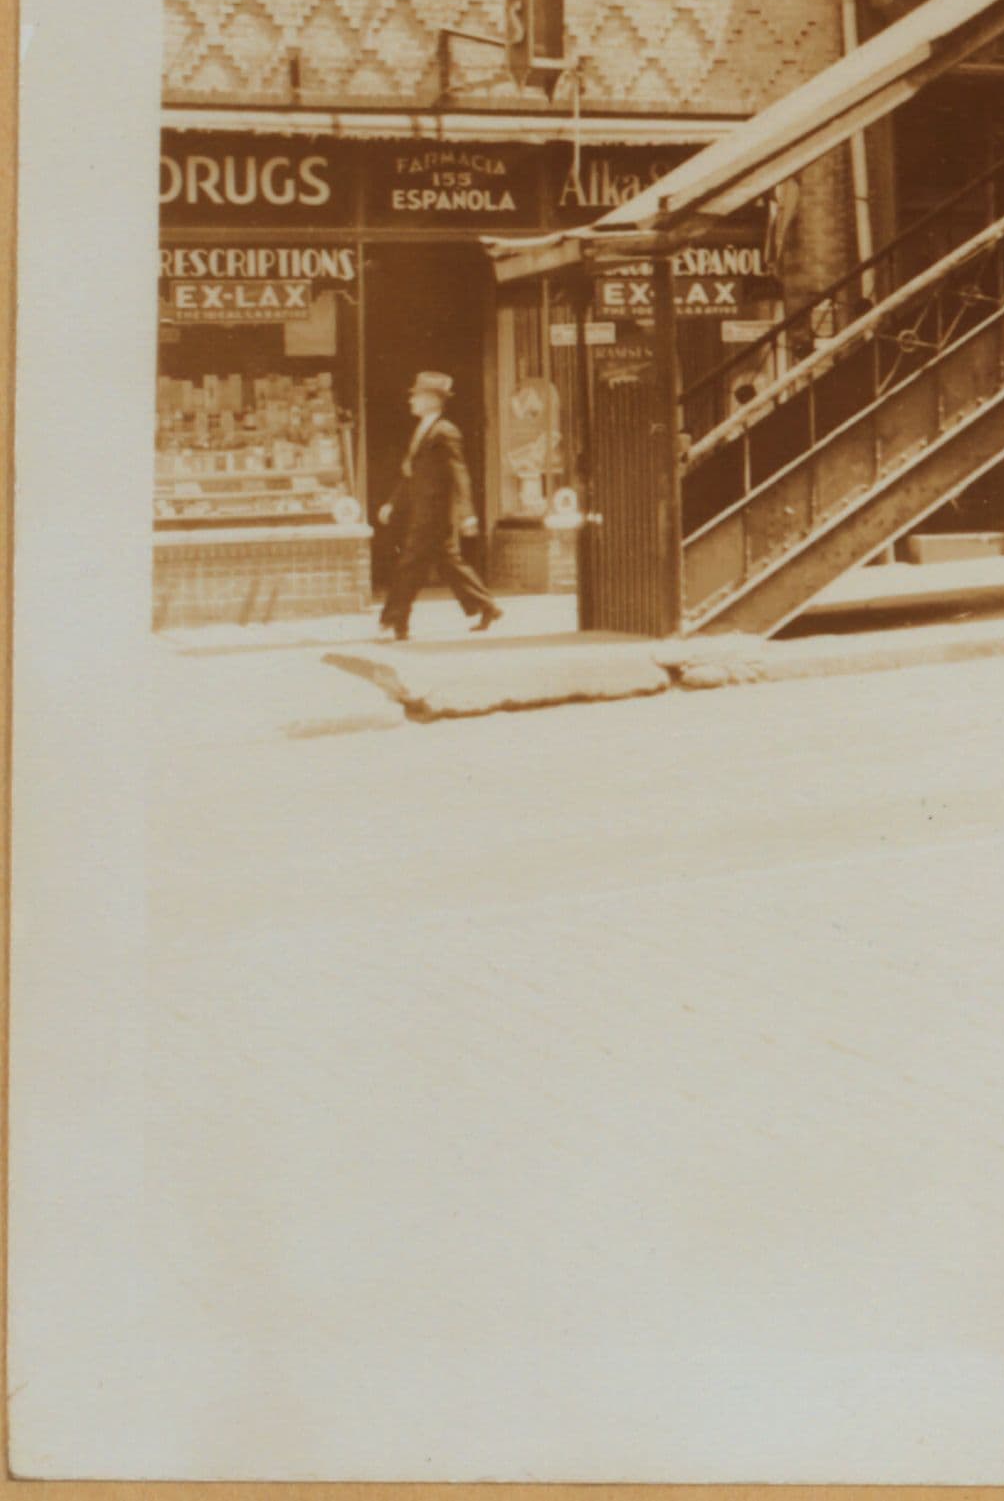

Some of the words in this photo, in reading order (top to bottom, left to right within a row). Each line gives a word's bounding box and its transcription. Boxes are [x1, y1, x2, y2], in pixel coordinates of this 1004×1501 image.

[158, 155, 332, 206] DRUGS
[432, 172, 474, 188] 155
[390, 185, 517, 212] ESPAÑOLA
[175, 284, 307, 309] EX-LAX
